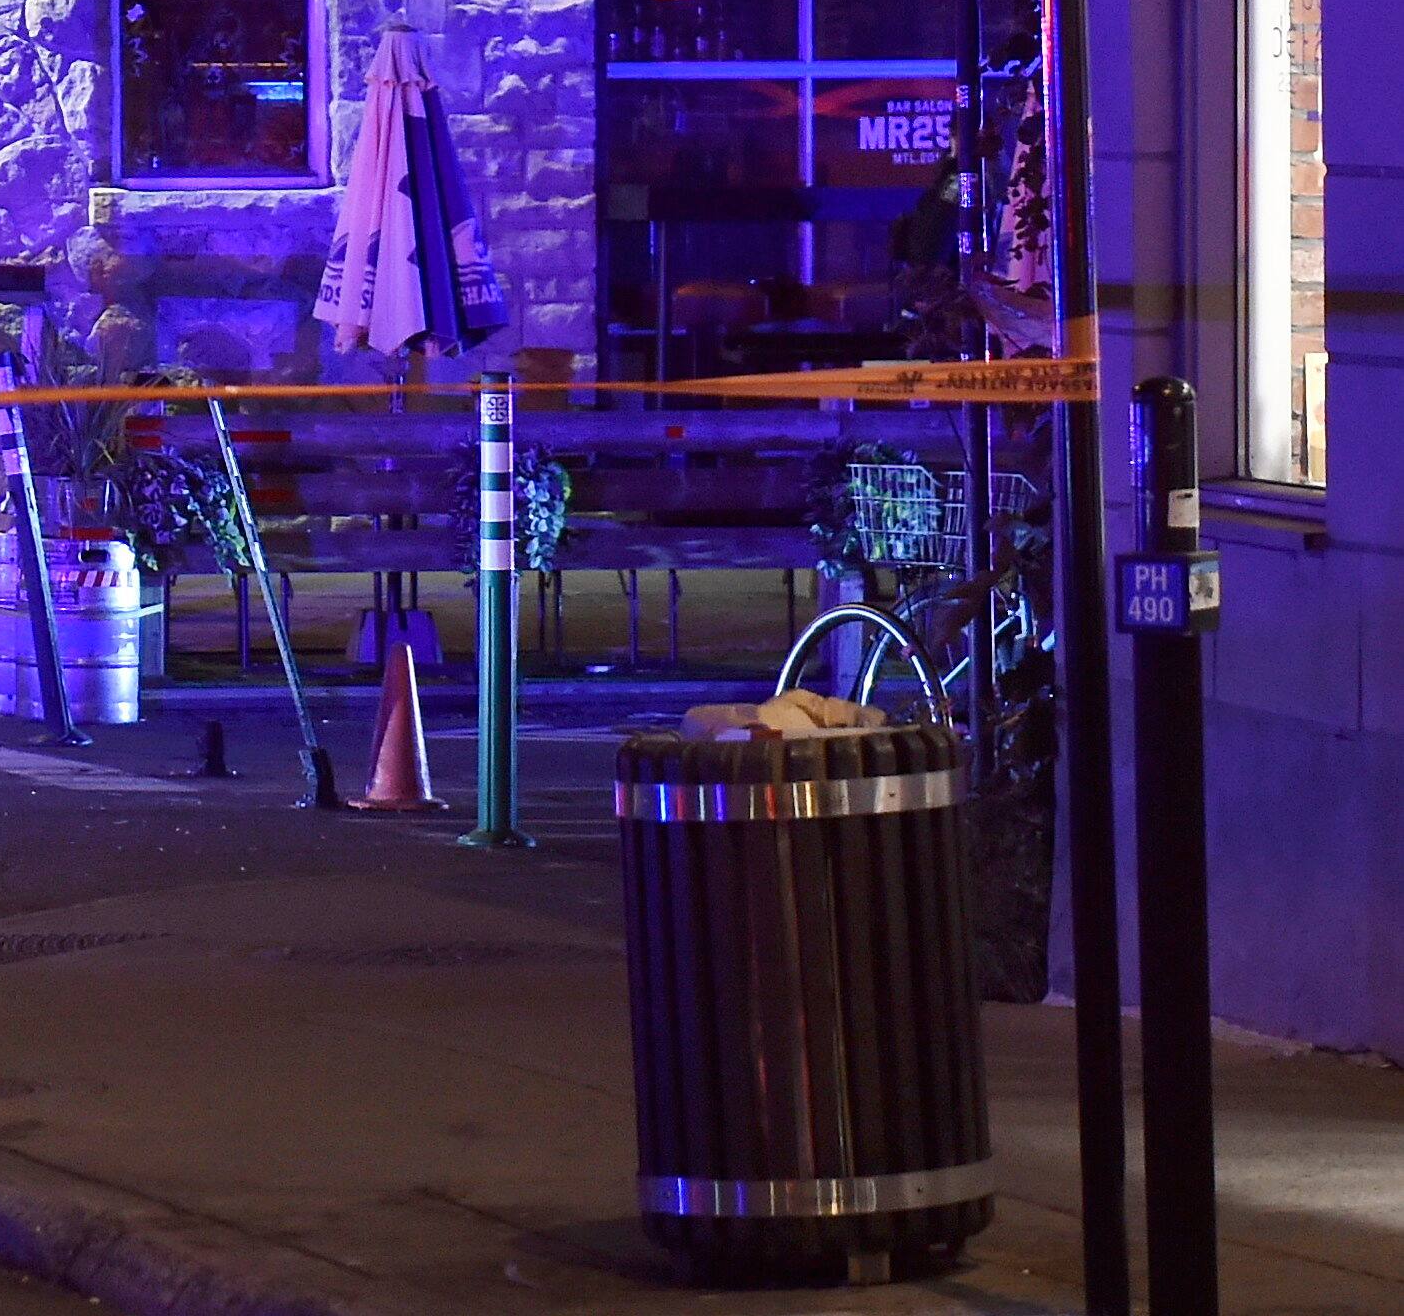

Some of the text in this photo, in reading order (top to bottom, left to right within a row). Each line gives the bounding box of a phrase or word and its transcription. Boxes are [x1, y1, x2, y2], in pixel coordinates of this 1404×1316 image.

[887, 100, 911, 113] BAR
[859, 116, 951, 150] MR25
[1135, 565, 1168, 591] PH
[1128, 596, 1174, 622] 490
